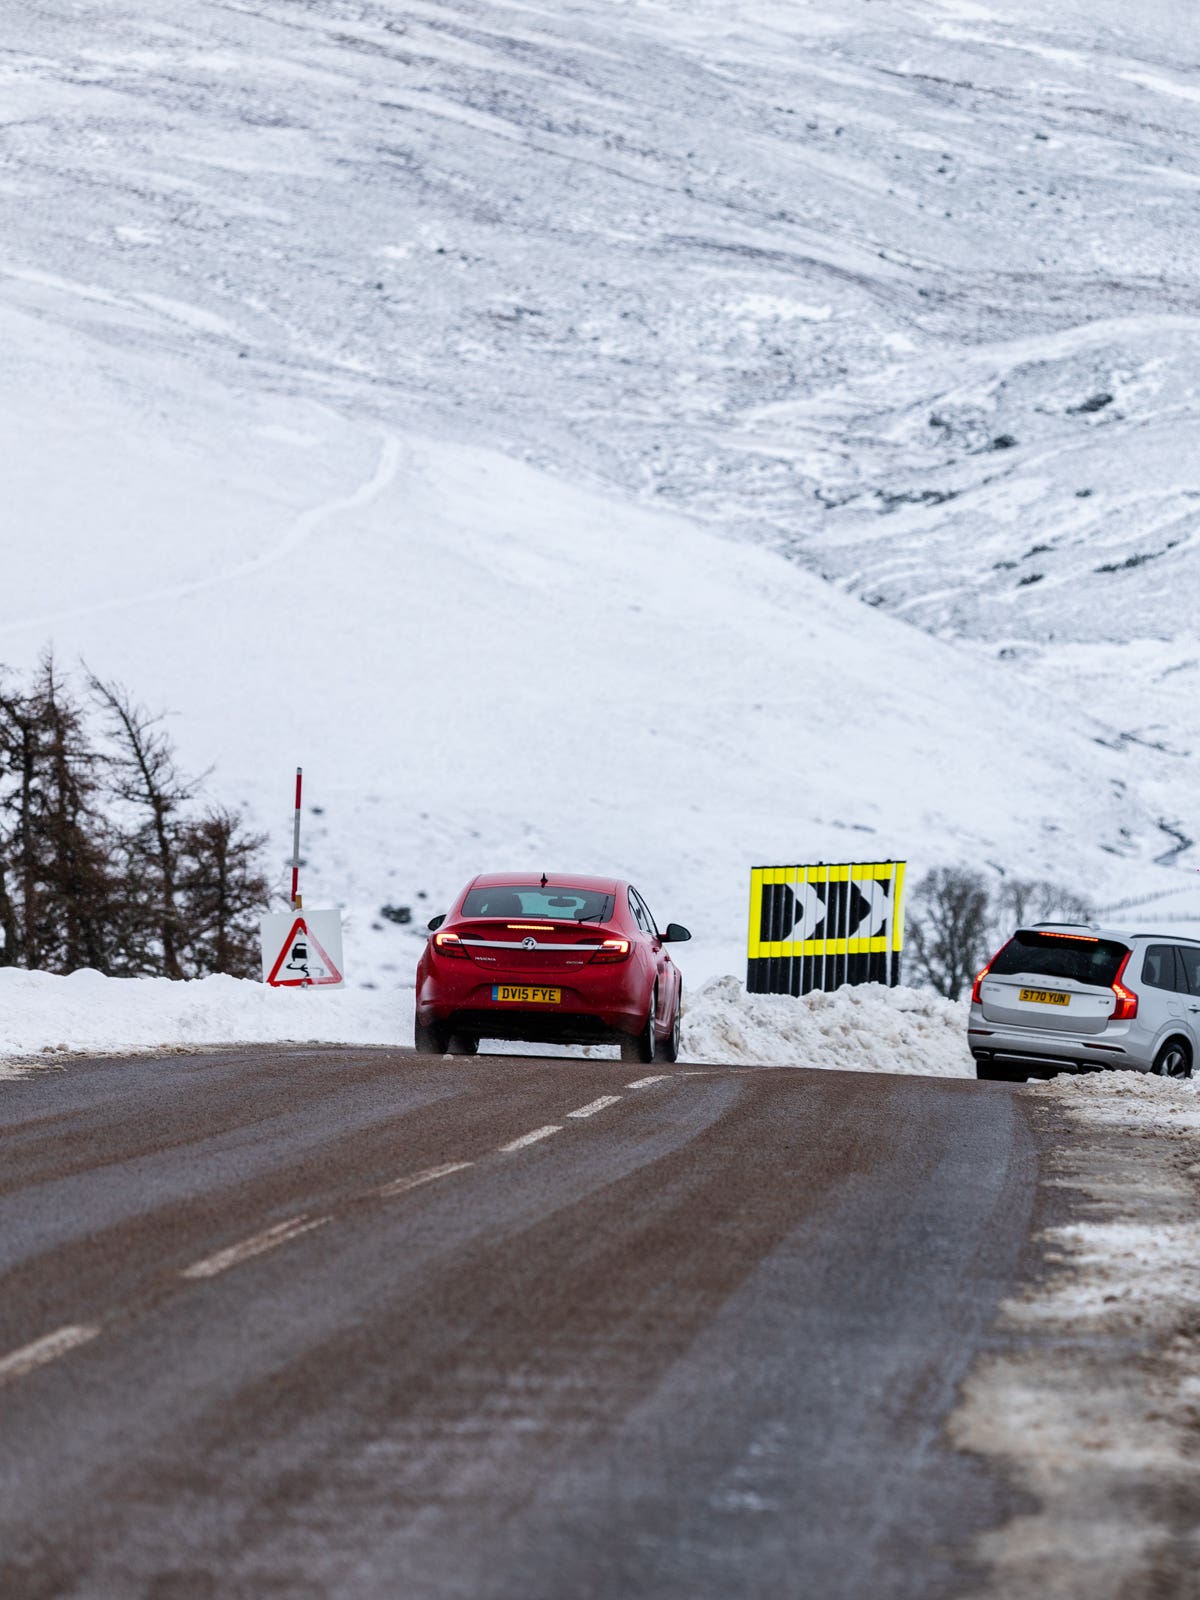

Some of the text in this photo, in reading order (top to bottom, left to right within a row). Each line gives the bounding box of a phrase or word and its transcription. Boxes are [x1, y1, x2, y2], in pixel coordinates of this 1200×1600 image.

[502, 988, 556, 1001] DV15 FYE
[1023, 990, 1067, 1003] ST70 YUN
